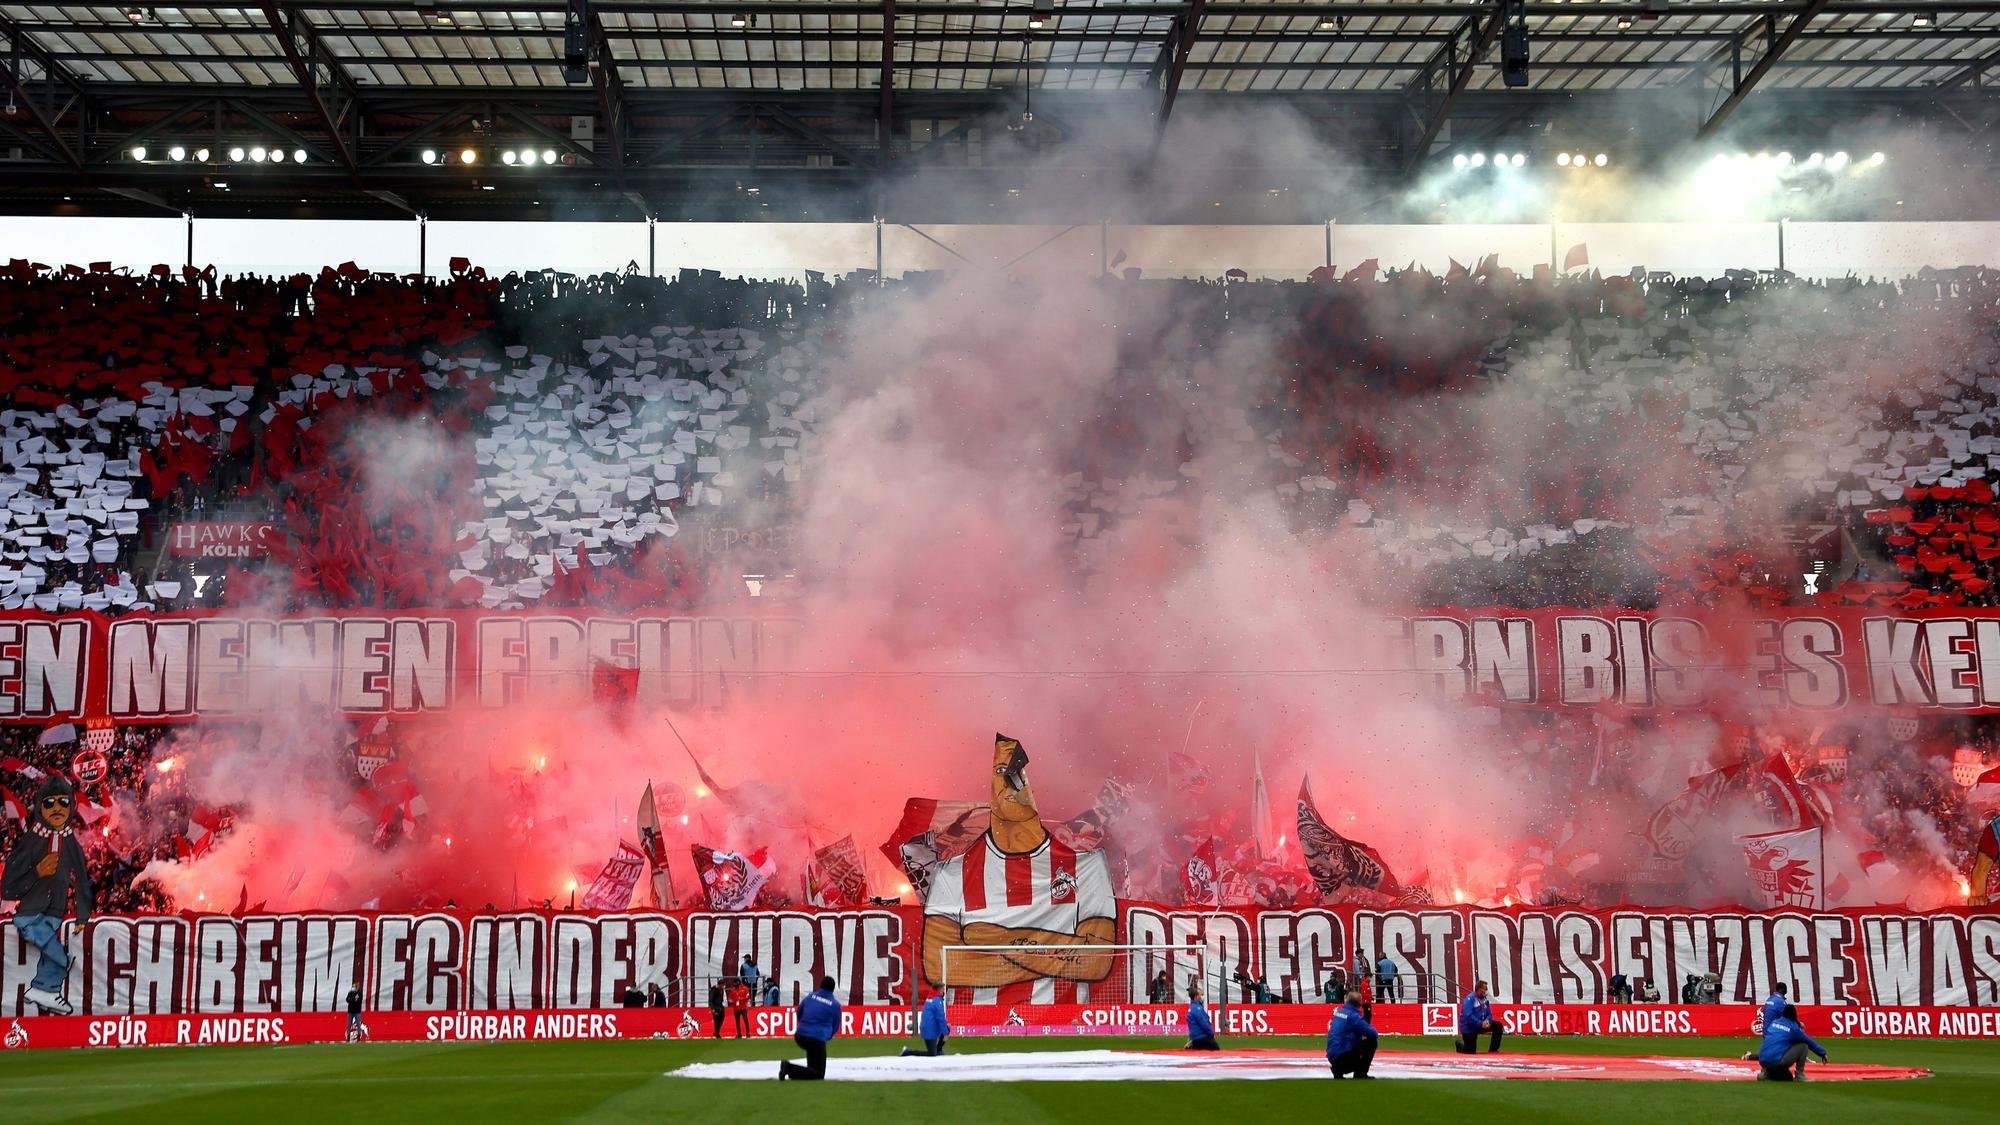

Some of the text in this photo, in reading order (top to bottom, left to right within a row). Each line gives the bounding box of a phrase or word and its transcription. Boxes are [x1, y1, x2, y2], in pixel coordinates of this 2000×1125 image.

[176, 525, 273, 549] HAWKS
[203, 543, 250, 557] KÖLN
[107, 618, 456, 719] MEINEN
[476, 614, 805, 712] FREUN
[1378, 615, 1539, 707] RN
[1557, 615, 1708, 710] BIS
[62, 916, 191, 1017] ICH
[196, 914, 371, 1013] BEIM
[374, 913, 464, 1011] FC
[468, 914, 547, 1010] IN
[550, 912, 682, 1010] DER
[687, 910, 903, 1007] KURVE
[1126, 907, 1255, 1005] DER
[1257, 907, 1346, 1005] FC
[1353, 910, 1465, 1005] IST
[1470, 911, 1608, 1005] DAS
[1610, 911, 1859, 1006] EINZIGE
[1860, 914, 2000, 1007] WAS
[198, 1018, 290, 1042] ANDERS.
[426, 1012, 623, 1040] SPÜRBAR ANDERS.
[756, 1008, 854, 1036] SPÜR
[1608, 1010, 1697, 1033] ANDERS.
[1831, 1007, 1931, 1035] SPÜRBAR
